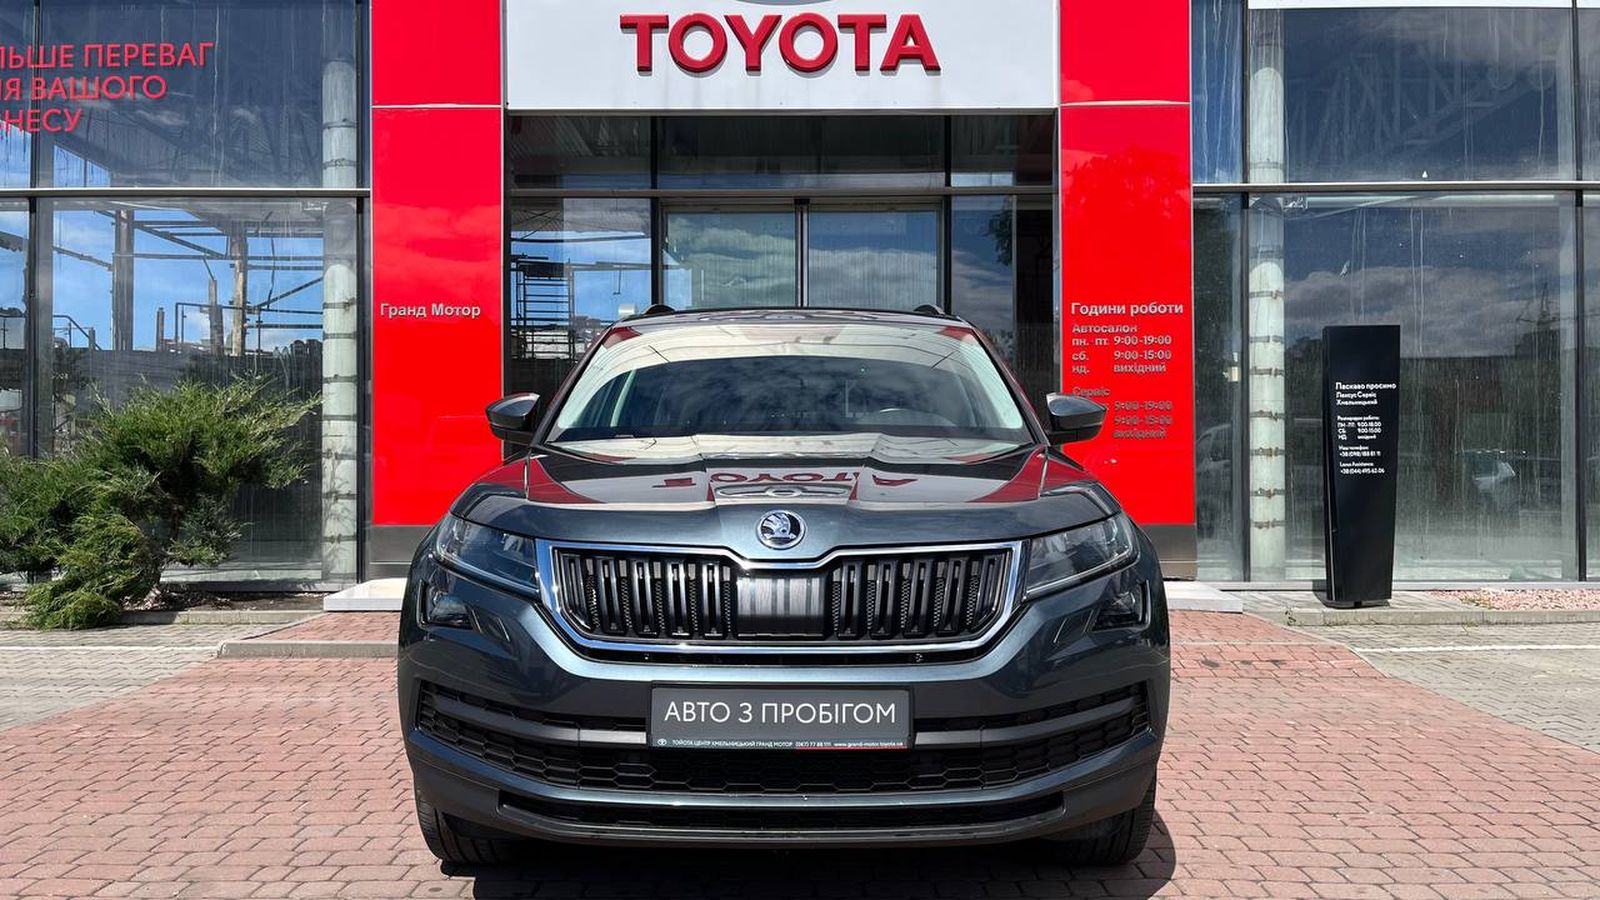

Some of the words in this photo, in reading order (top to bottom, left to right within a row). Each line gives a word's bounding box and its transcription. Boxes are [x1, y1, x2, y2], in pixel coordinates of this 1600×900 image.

[620, 13, 941, 73] TOYOTA
[84, 42, 214, 68] ПЕРЕВАГ
[0, 77, 21, 100] Я
[31, 75, 167, 100] ВАШОГО
[380, 303, 427, 318] Гранд
[431, 303, 481, 318] Мотор
[1071, 302, 1126, 316] Години
[1130, 302, 1184, 316] роботи
[1072, 324, 1138, 333] Автосалон
[1113, 362, 1167, 374] вихідний
[1366, 383, 1397, 391] просимо
[664, 701, 731, 723] АВТО
[738, 702, 753, 724] З
[761, 702, 897, 724] ПРОБІГОМ
